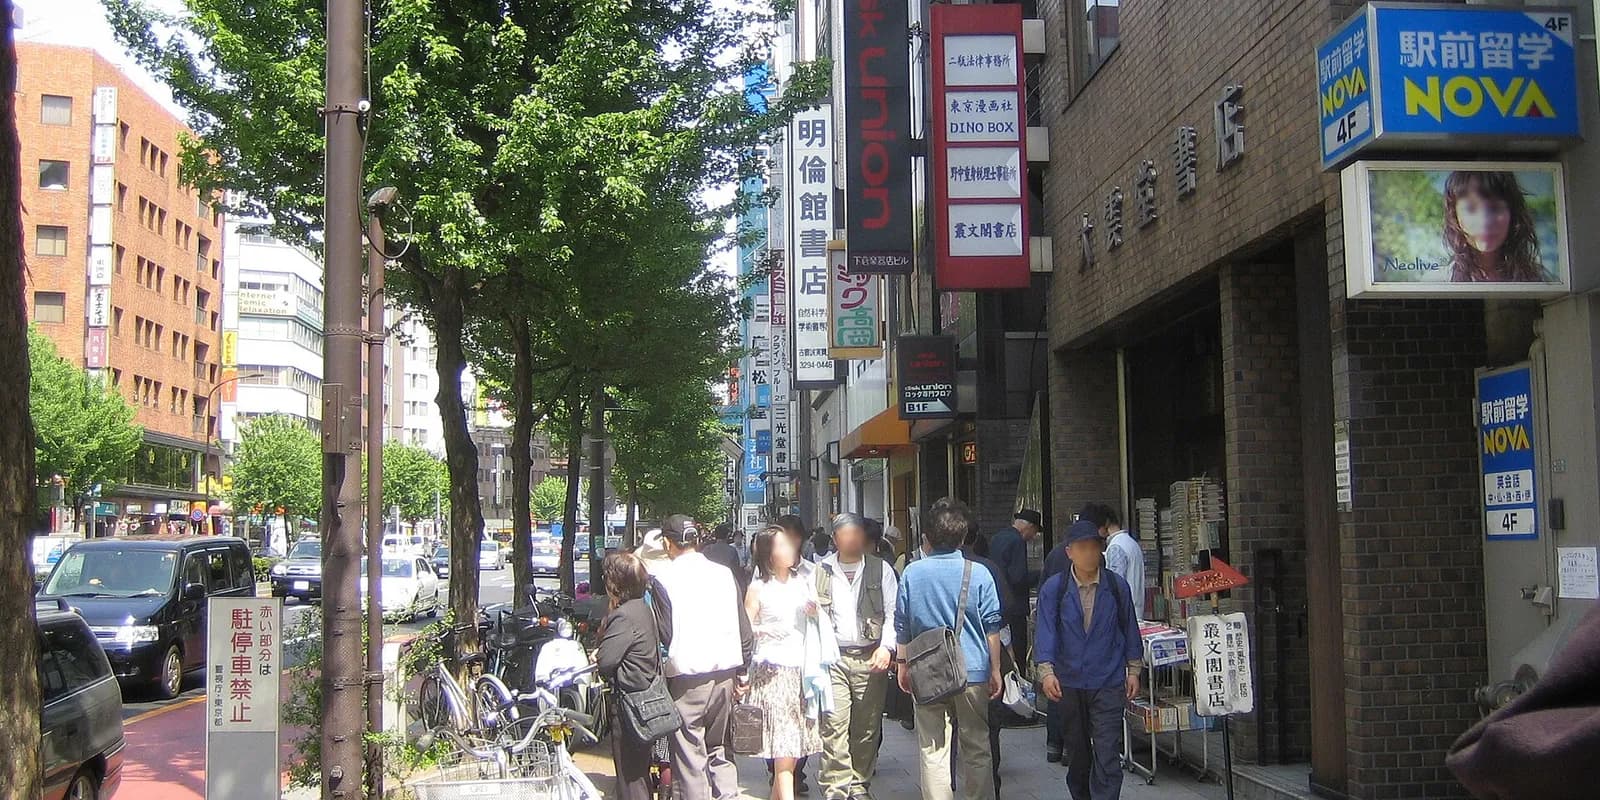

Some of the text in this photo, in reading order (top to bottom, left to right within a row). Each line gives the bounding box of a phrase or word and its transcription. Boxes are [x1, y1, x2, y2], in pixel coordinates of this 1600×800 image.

[1545, 16, 1569, 32] 4F
[1320, 28, 1366, 84] 駅前留学
[1399, 30, 1555, 70] 駅前留学
[950, 99, 1014, 114] 東京漫画社
[1321, 65, 1367, 118] NOVA
[1404, 75, 1558, 123] NOVA
[858, 47, 896, 230] union
[950, 122, 1015, 133] DINO BOX
[1336, 111, 1357, 144] 4F
[798, 119, 828, 296] 明倫館書店
[953, 222, 1017, 239] 叢文閣書店
[1384, 257, 1440, 272] Neolive
[240, 292, 276, 300] nternet
[907, 403, 929, 412] B1F
[1481, 393, 1529, 426] 駅前留学
[1484, 424, 1530, 457] NOVA
[1497, 473, 1520, 489] 英会話
[1502, 512, 1517, 532] 4F
[259, 605, 272, 676] 赤い部分は
[230, 608, 253, 723] 駐停車禁止
[1203, 622, 1225, 707] 叢文閣書店
[214, 665, 223, 726] 警視庁・東京都
